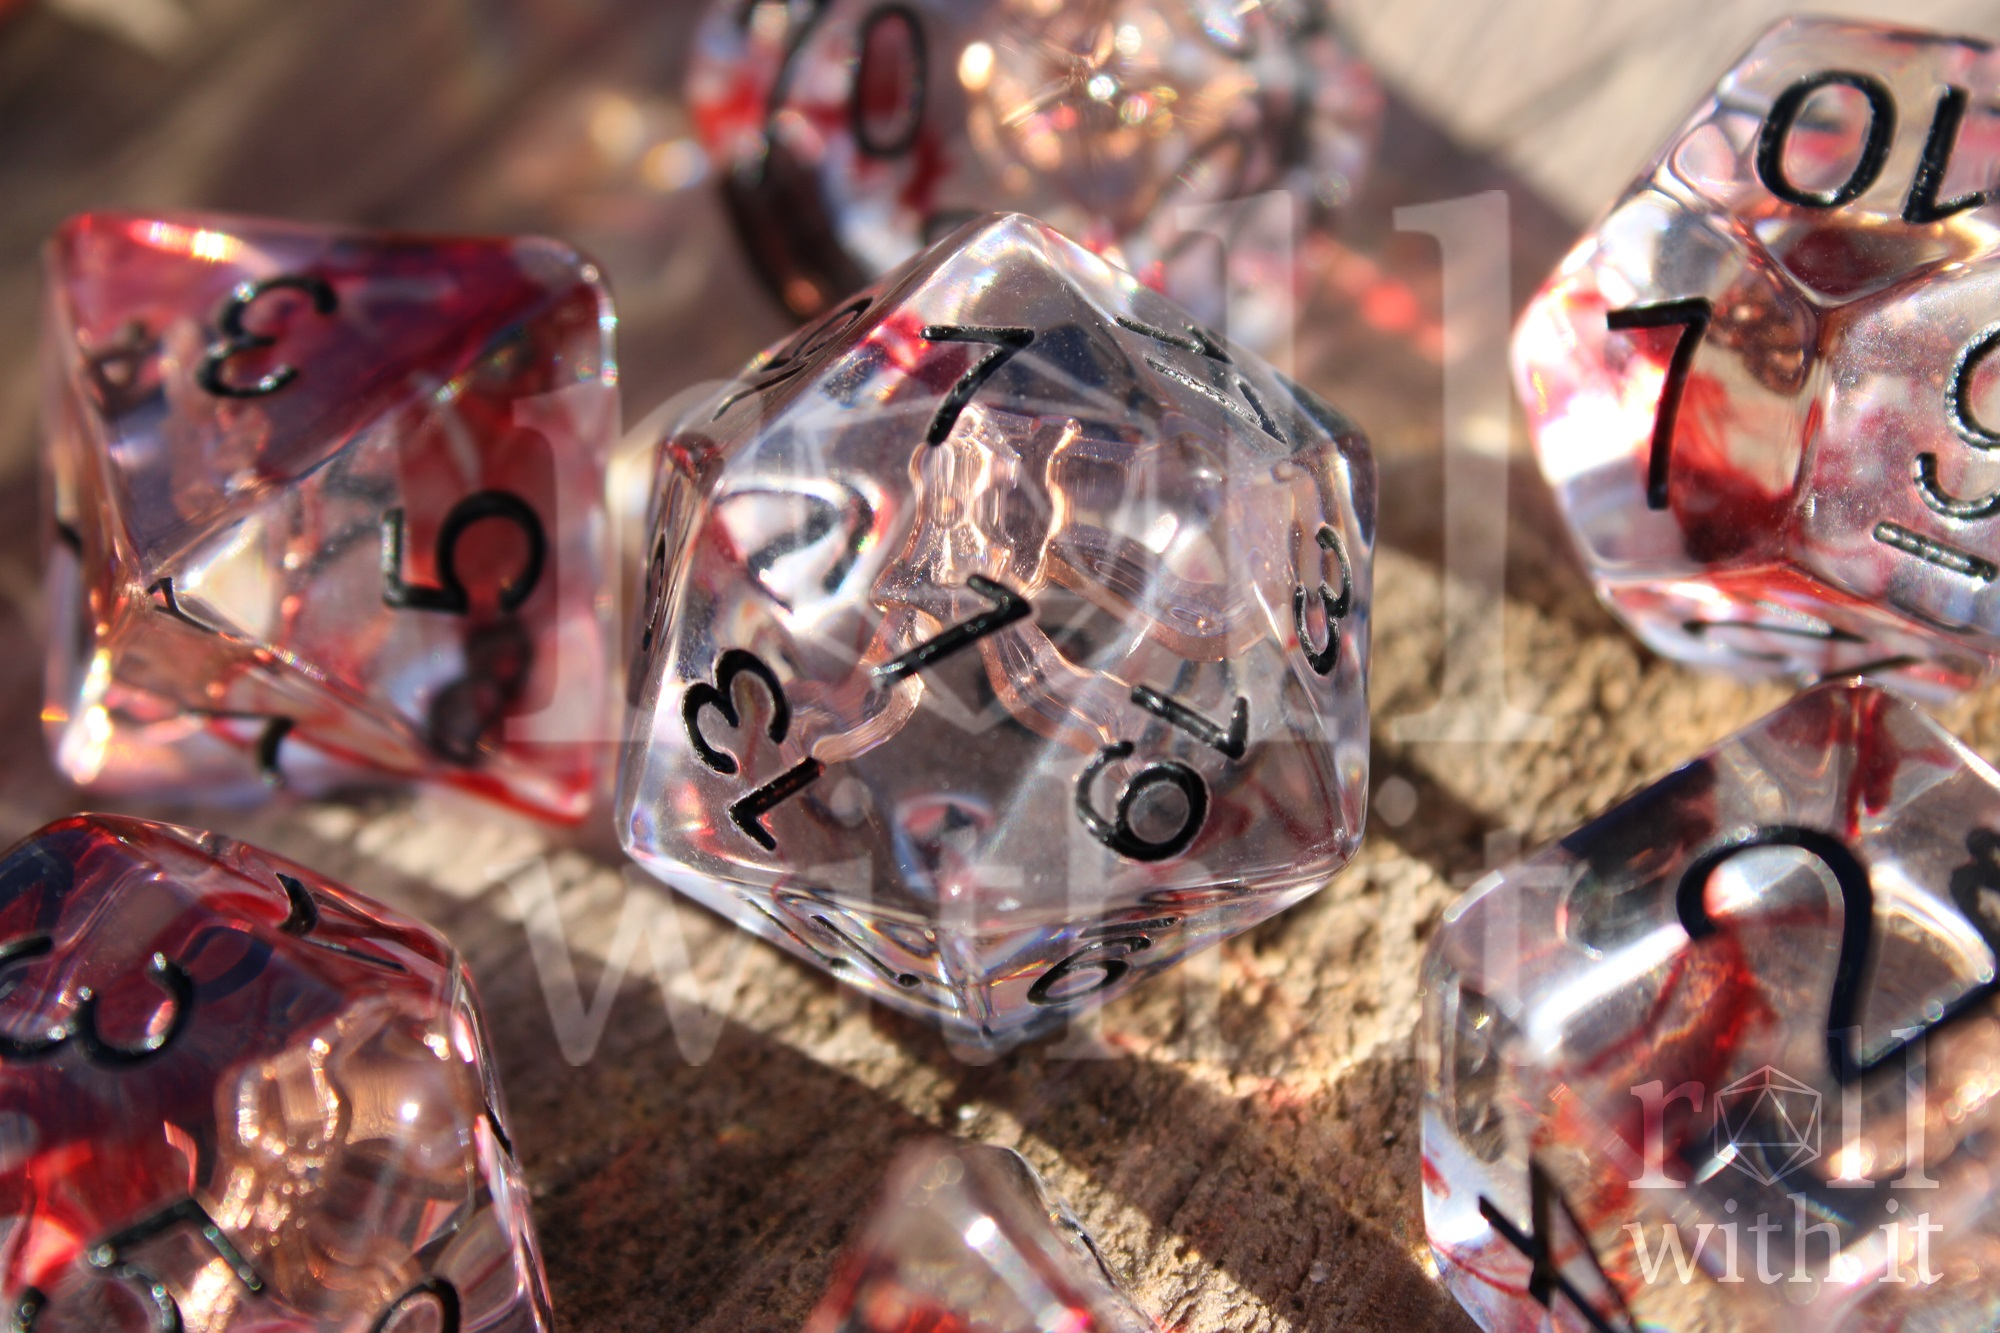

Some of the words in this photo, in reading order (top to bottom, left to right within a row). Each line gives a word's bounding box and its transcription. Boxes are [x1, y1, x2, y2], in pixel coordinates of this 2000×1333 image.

[197, 274, 338, 398] 3
[920, 323, 1034, 447] 7
[1606, 297, 1712, 510] 7
[380, 488, 548, 615] 5
[682, 647, 826, 851] 13
